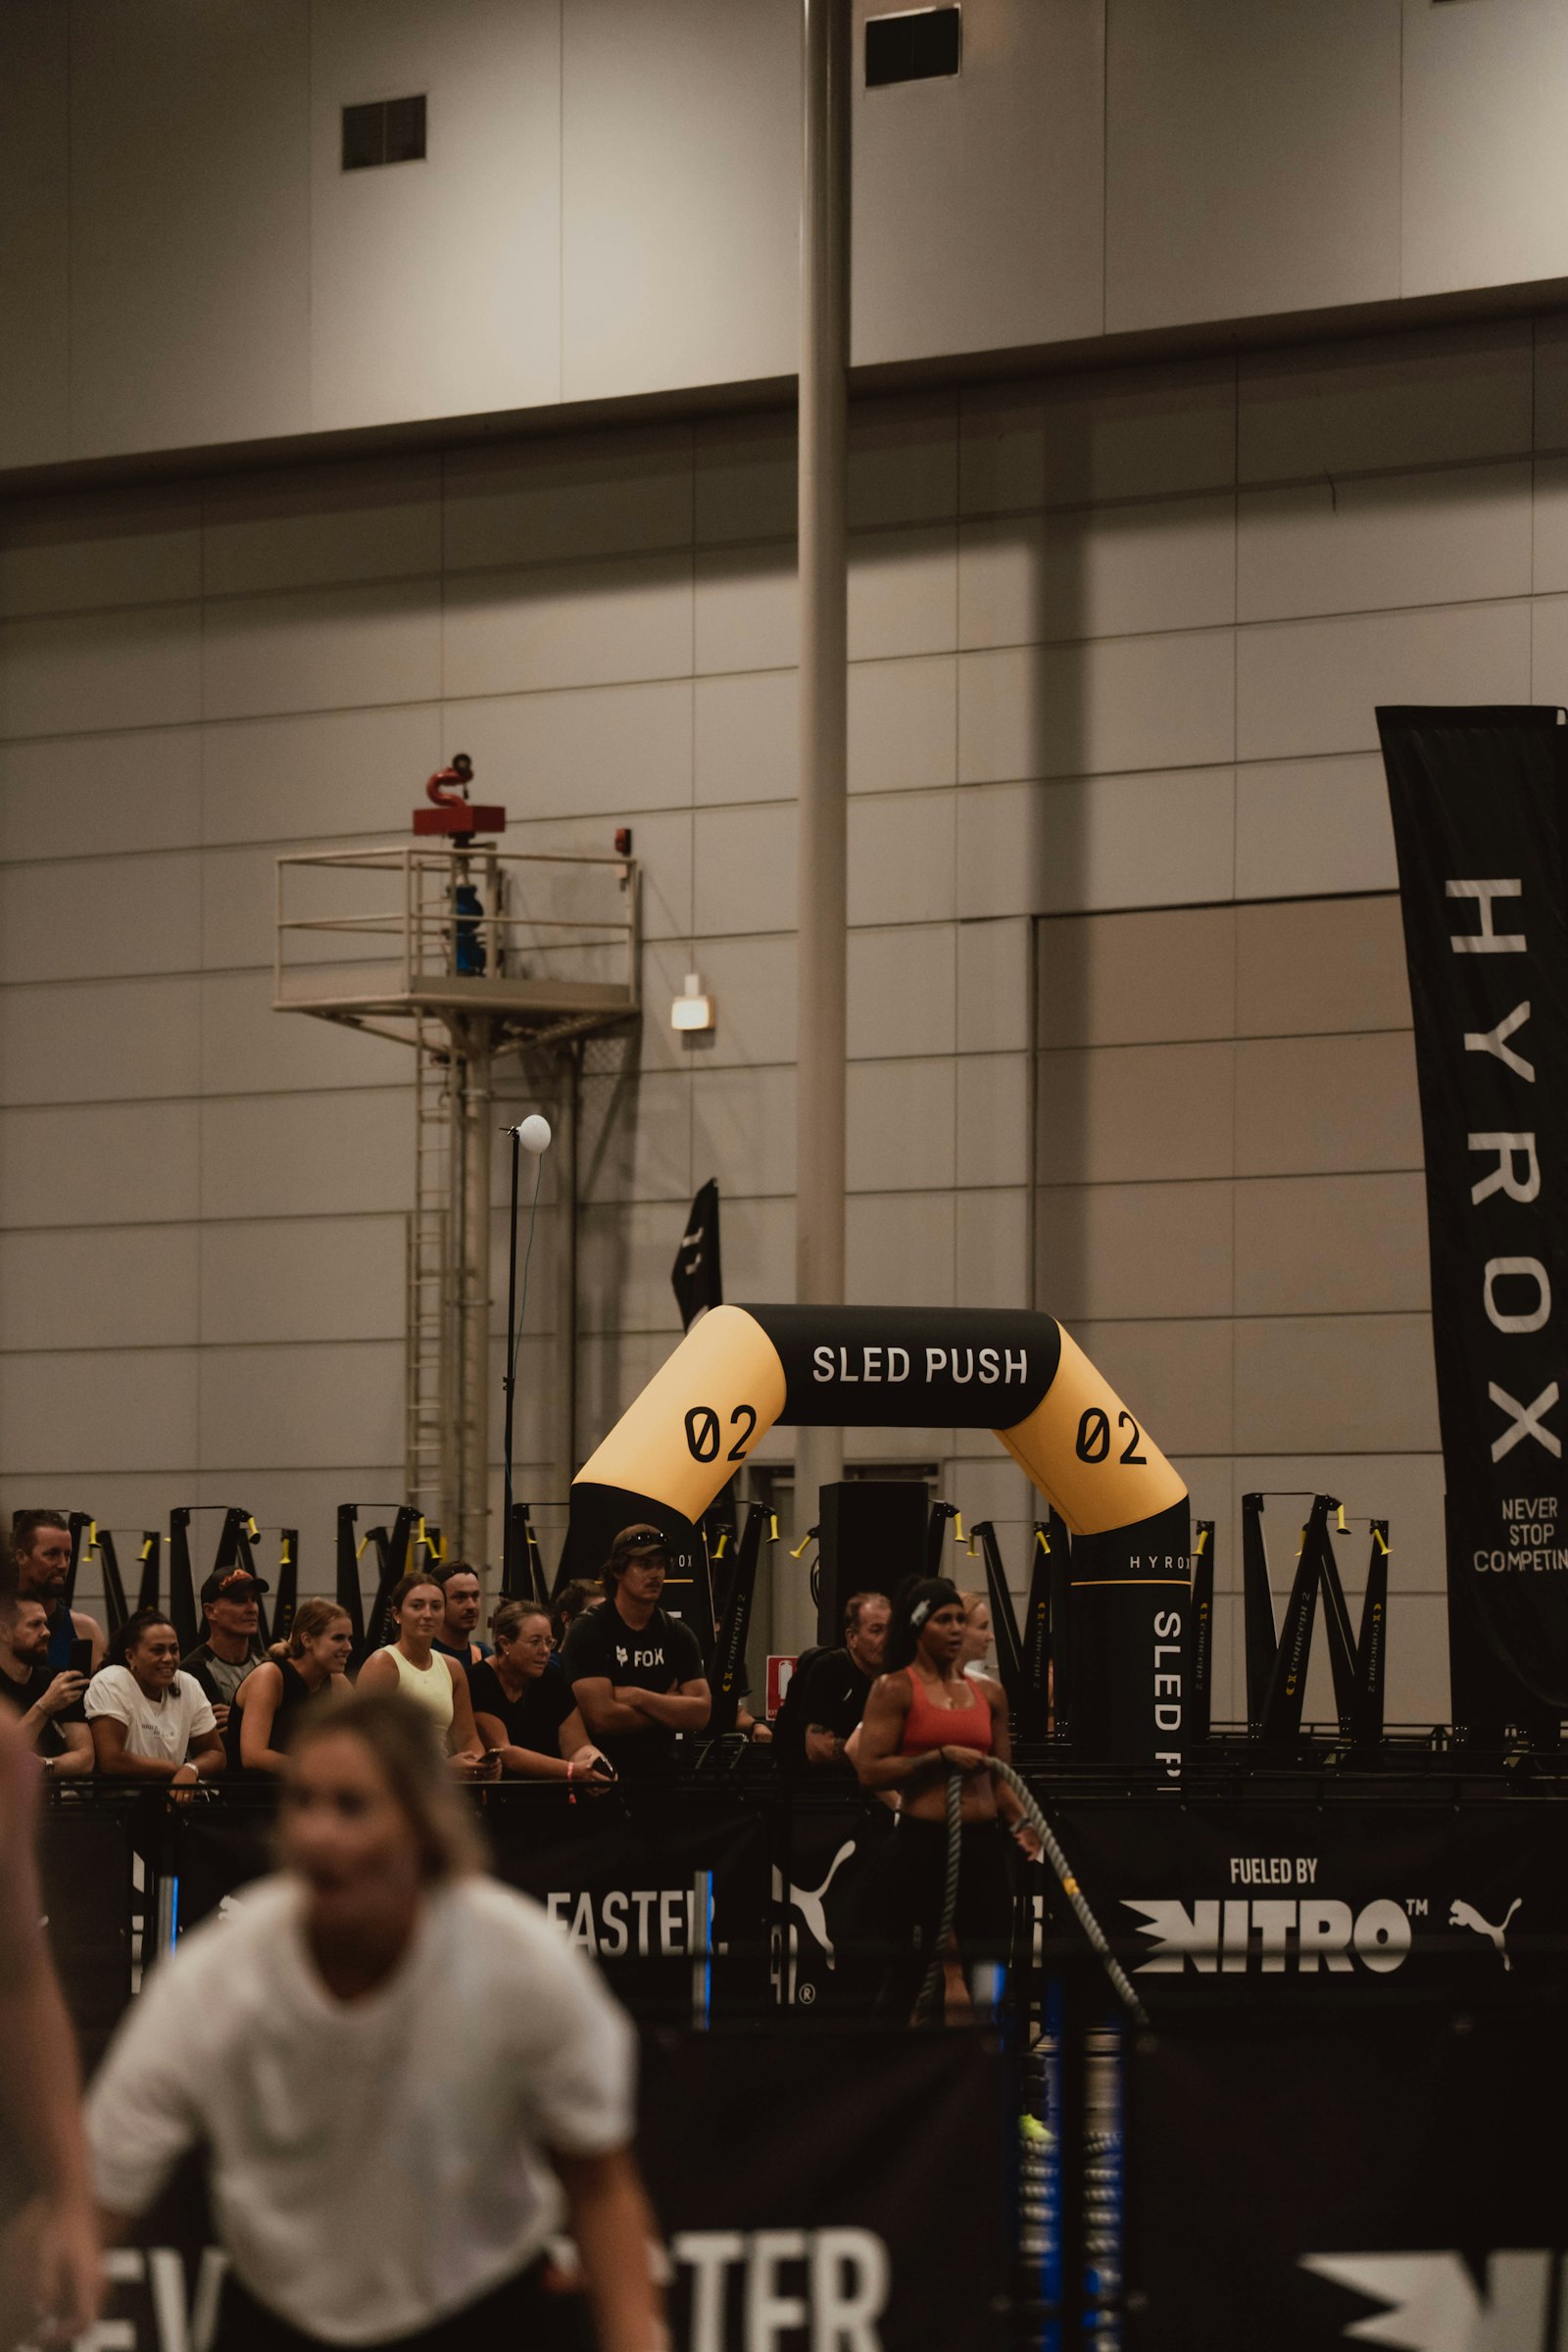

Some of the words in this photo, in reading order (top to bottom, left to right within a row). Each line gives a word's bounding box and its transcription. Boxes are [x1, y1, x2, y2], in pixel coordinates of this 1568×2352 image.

[1445, 879, 1561, 1463] HYROX
[812, 1346, 910, 1384] SLED
[925, 1347, 1029, 1385] PUSH
[684, 1404, 757, 1463] 02
[1076, 1406, 1148, 1465] 02
[1501, 1496, 1558, 1520] NEVER
[1509, 1523, 1555, 1546] STOP
[1473, 1548, 1568, 1573] COMPETIN
[633, 1647, 665, 1668] FOX
[1153, 1610, 1182, 1732] SLED
[1230, 1857, 1293, 1884] FUELED
[1296, 1857, 1318, 1884] BY
